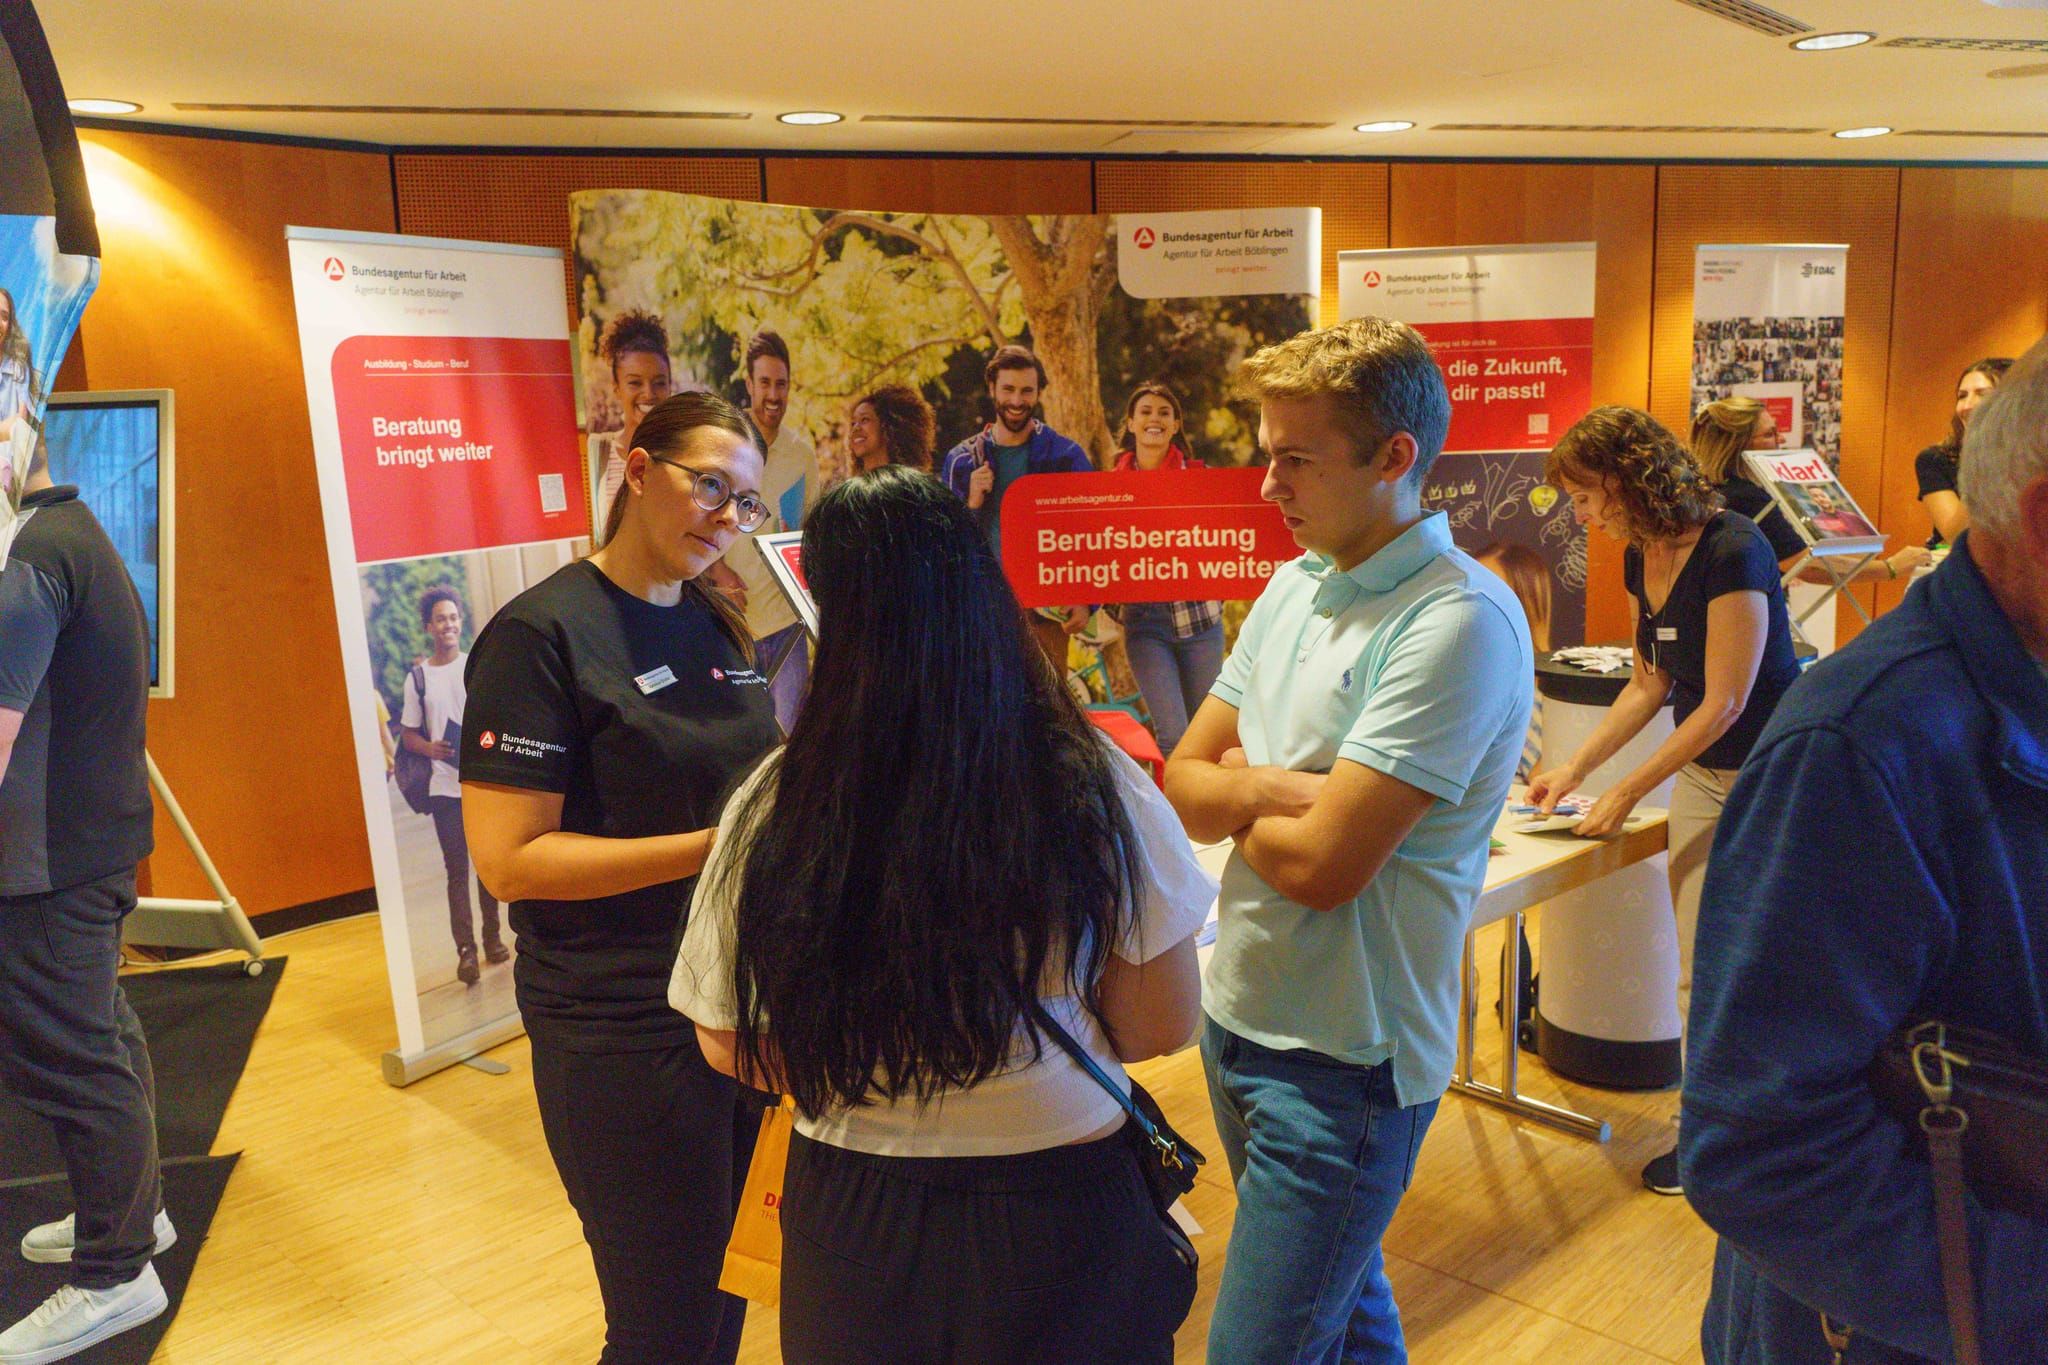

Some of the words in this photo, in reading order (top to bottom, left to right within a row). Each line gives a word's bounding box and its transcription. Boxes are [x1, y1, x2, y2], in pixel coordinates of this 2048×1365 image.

[1163, 231, 1241, 243] Bundesagentur
[1244, 229, 1259, 239] für
[1262, 228, 1293, 238] Arbeit
[1163, 250, 1197, 261] Agentur
[1200, 248, 1213, 257] für
[1215, 247, 1242, 257] Arbeit
[1245, 246, 1288, 257] Böblingen
[352, 265, 422, 280] Bundesagentur
[424, 269, 438, 280] für
[440, 271, 467, 282] Arbeit
[1386, 273, 1449, 283] Bundesagentur
[1465, 271, 1490, 280] Arbeit
[354, 285, 386, 297] Agentur
[402, 287, 425, 297] Arbeit
[364, 359, 407, 370] Ausbildung
[413, 359, 444, 369] Studium
[450, 359, 469, 369] Beruf
[1448, 360, 1478, 377] die
[1484, 357, 1567, 376] Zukunft,
[1452, 384, 1479, 401] dir
[1484, 381, 1545, 404] passt!
[372, 416, 462, 438] Beratung
[376, 444, 434, 469] bringt
[438, 442, 493, 461] weiter
[1771, 459, 1829, 481] klar!
[1035, 493, 1134, 505] www.arbeitsagentur.de
[1037, 525, 1256, 553] Berufsberatung
[1038, 560, 1120, 588] bringt
[1128, 556, 1188, 582] dich
[500, 742, 514, 752] für
[515, 745, 543, 759] Arbeit
[502, 733, 567, 753] Bundesagentur
